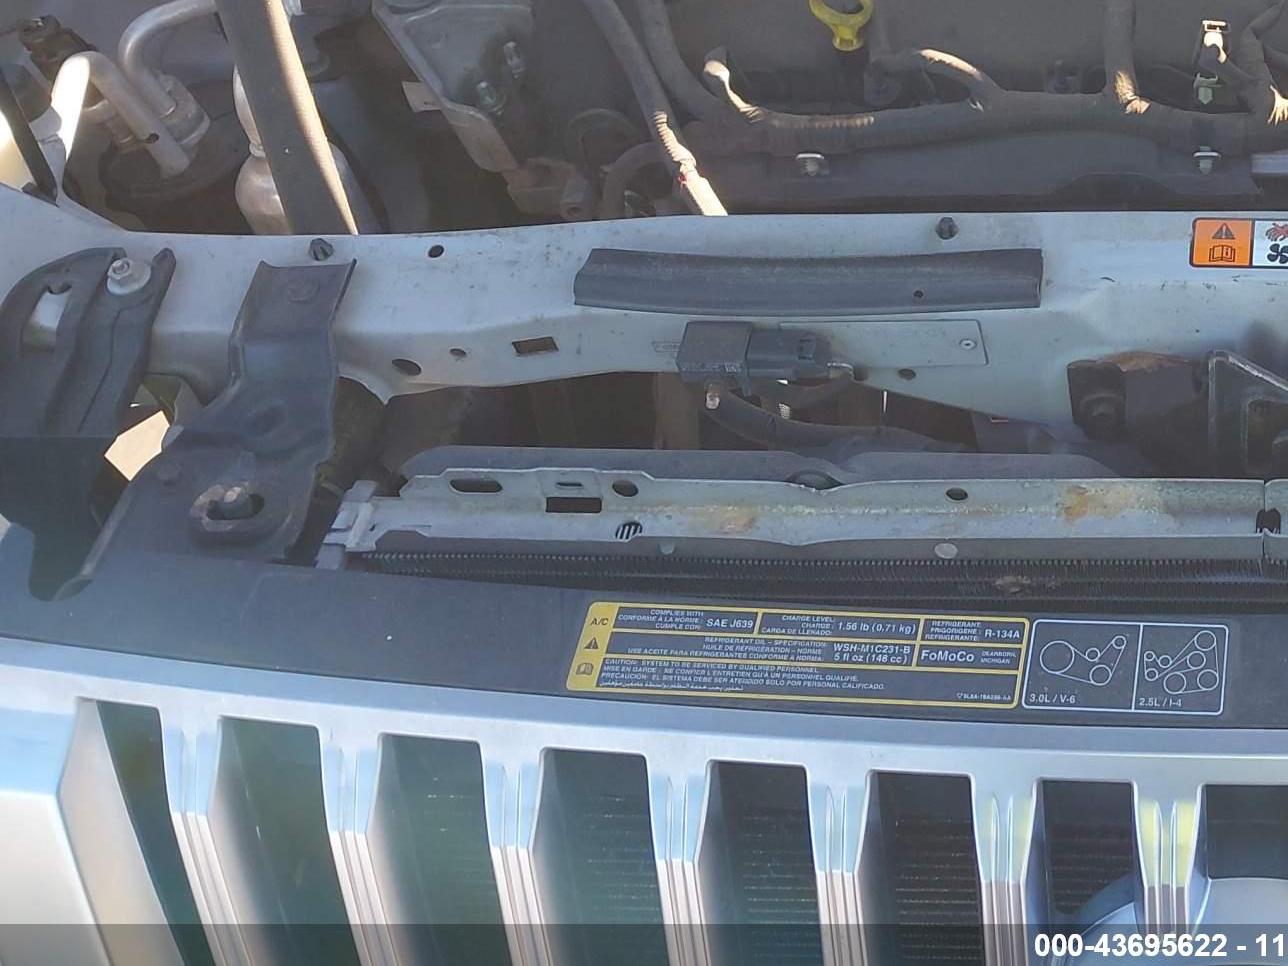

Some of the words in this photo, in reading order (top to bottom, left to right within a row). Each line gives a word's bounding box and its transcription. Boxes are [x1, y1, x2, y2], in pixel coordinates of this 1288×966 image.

[590, 618, 608, 626] A/C
[706, 618, 728, 628] SAE
[730, 619, 754, 628] J639
[838, 622, 857, 631] 1.56
[860, 622, 869, 631] lb
[898, 624, 916, 635] kg)
[984, 629, 1020, 638] R-134A
[833, 643, 910, 654] WSH-M1C231-B
[834, 652, 841, 661] 5
[842, 653, 850, 662] fl
[851, 654, 864, 662] oz
[866, 653, 888, 663] (148
[890, 655, 907, 665] cc)
[920, 649, 975, 662] FoMoCo
[663, 674, 691, 682] SISTEMA
[1029, 693, 1050, 703] 3.0L
[1059, 694, 1076, 704] V-6
[1139, 697, 1160, 707] 2.5L
[1169, 698, 1182, 707] I-4
